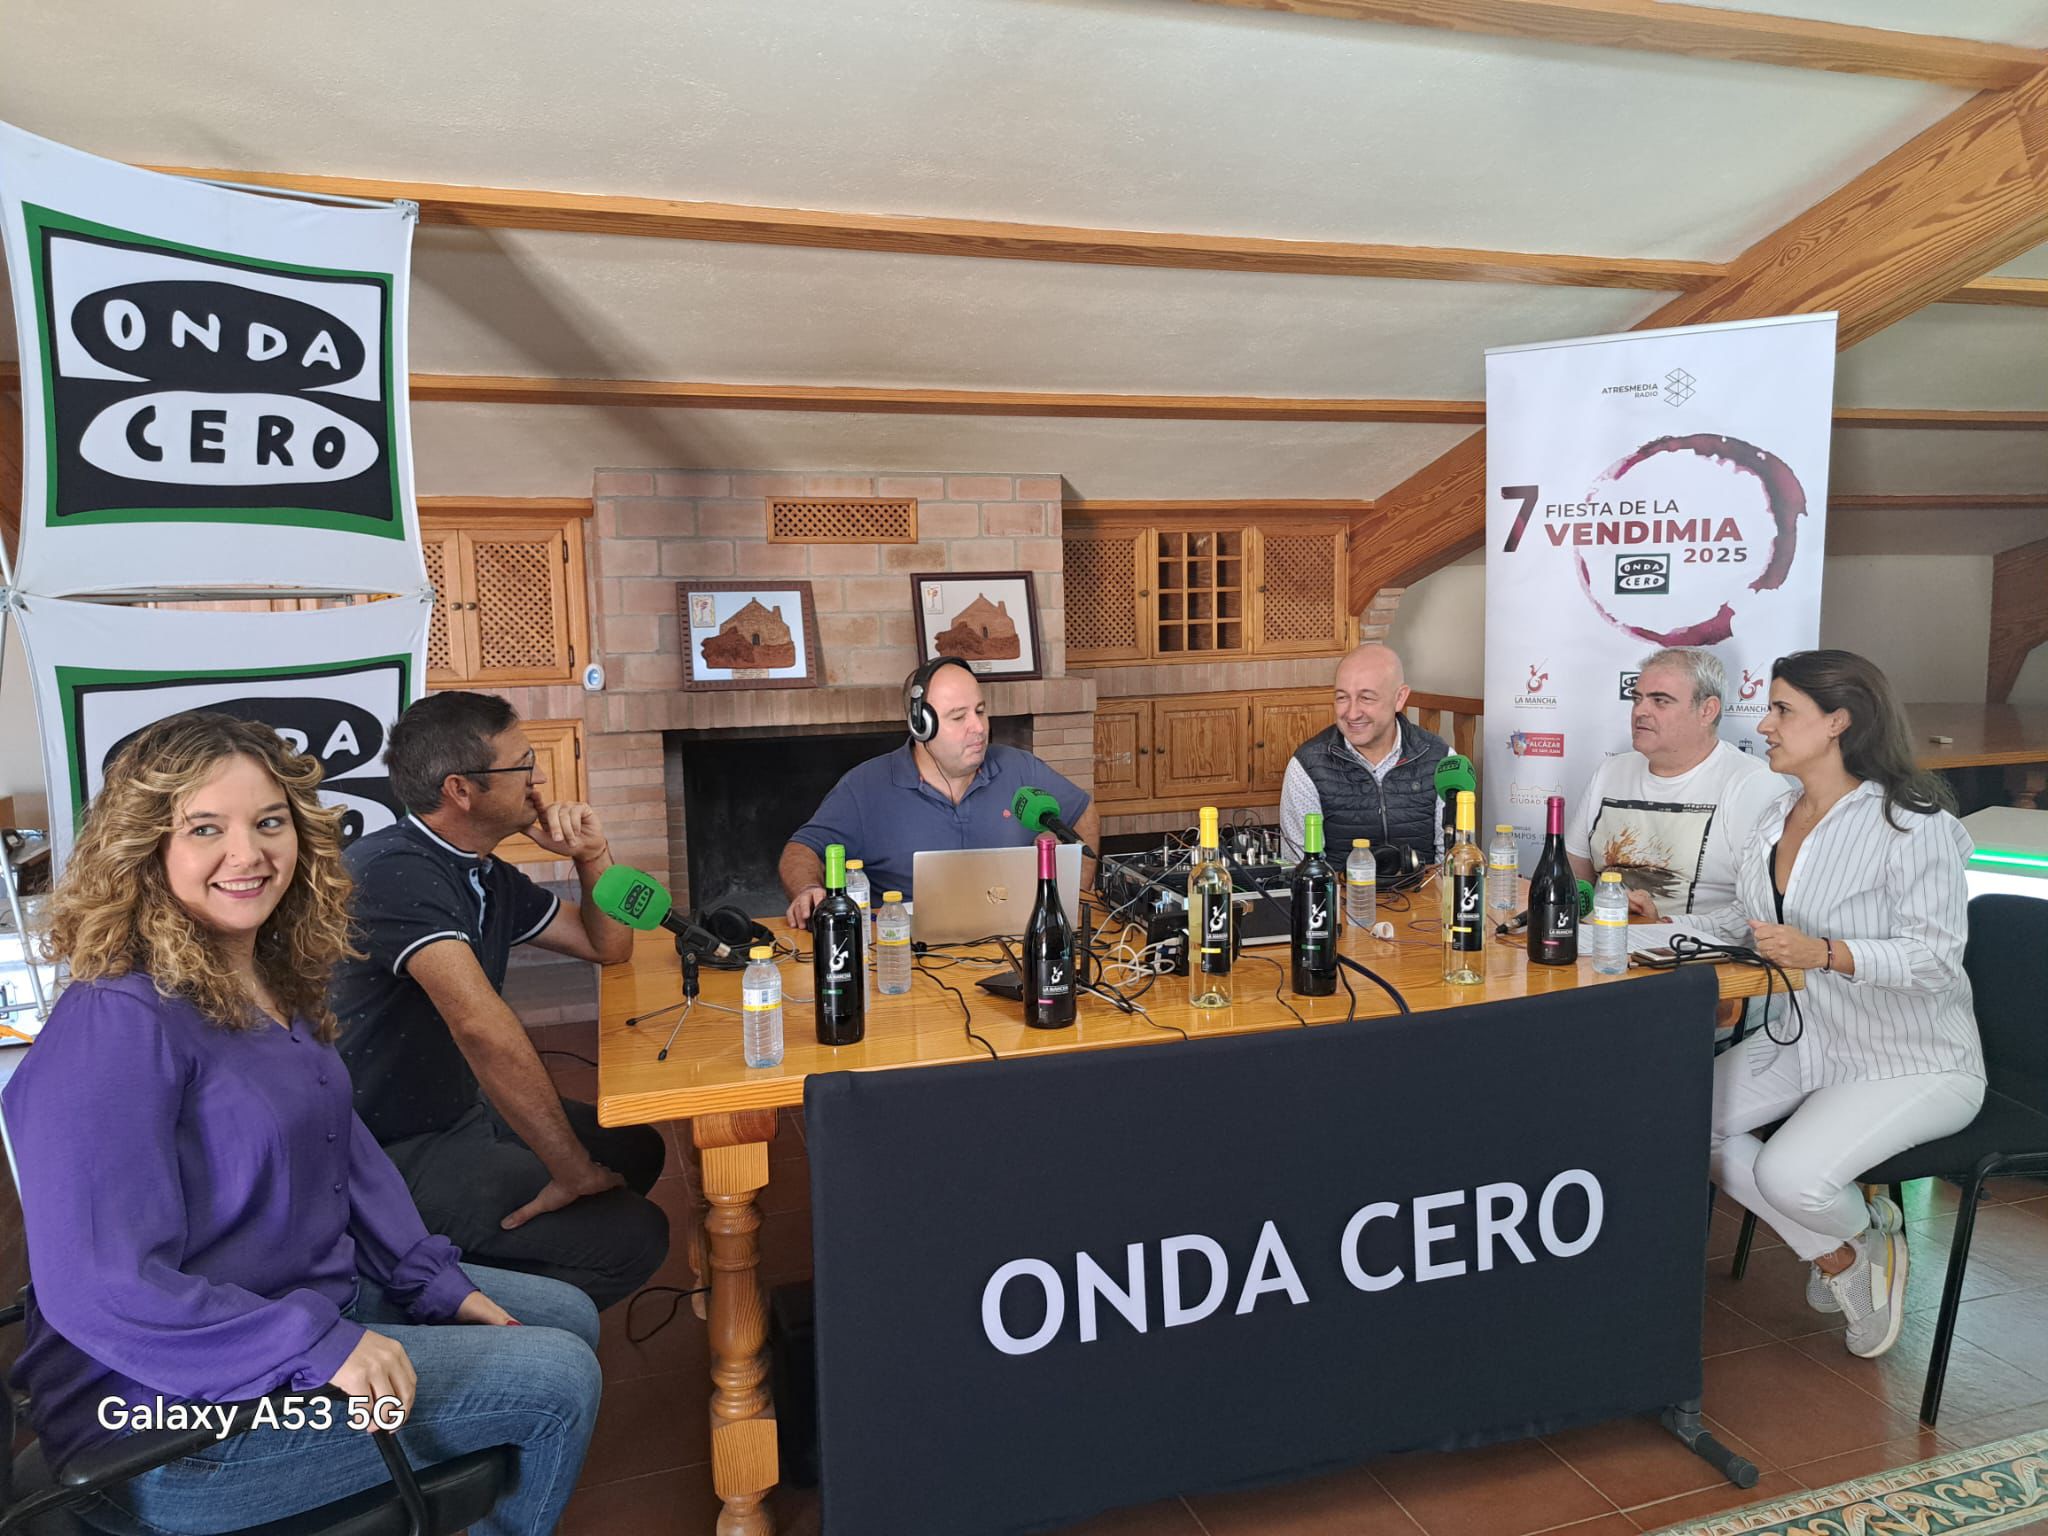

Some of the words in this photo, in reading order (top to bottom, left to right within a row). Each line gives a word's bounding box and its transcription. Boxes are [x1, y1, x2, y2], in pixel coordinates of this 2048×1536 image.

[103, 299, 342, 371] ONDA
[1601, 383, 1658, 394] ATRESMEDIA
[126, 405, 346, 470] CERO
[1545, 501, 1613, 518] FIESTA
[1619, 500, 1647, 515] DE
[1654, 499, 1679, 514] LA
[1501, 485, 1539, 553] 7
[1544, 517, 1743, 546] VENDIMIA
[1683, 547, 1748, 563] 2025
[1623, 563, 1660, 572] ONDA
[1625, 577, 1659, 586] CERO
[1514, 696, 1524, 704] LA
[1525, 696, 1557, 705] MANCHA
[981, 1219, 1310, 1355] ONDA
[1340, 1168, 1604, 1292] CERO
